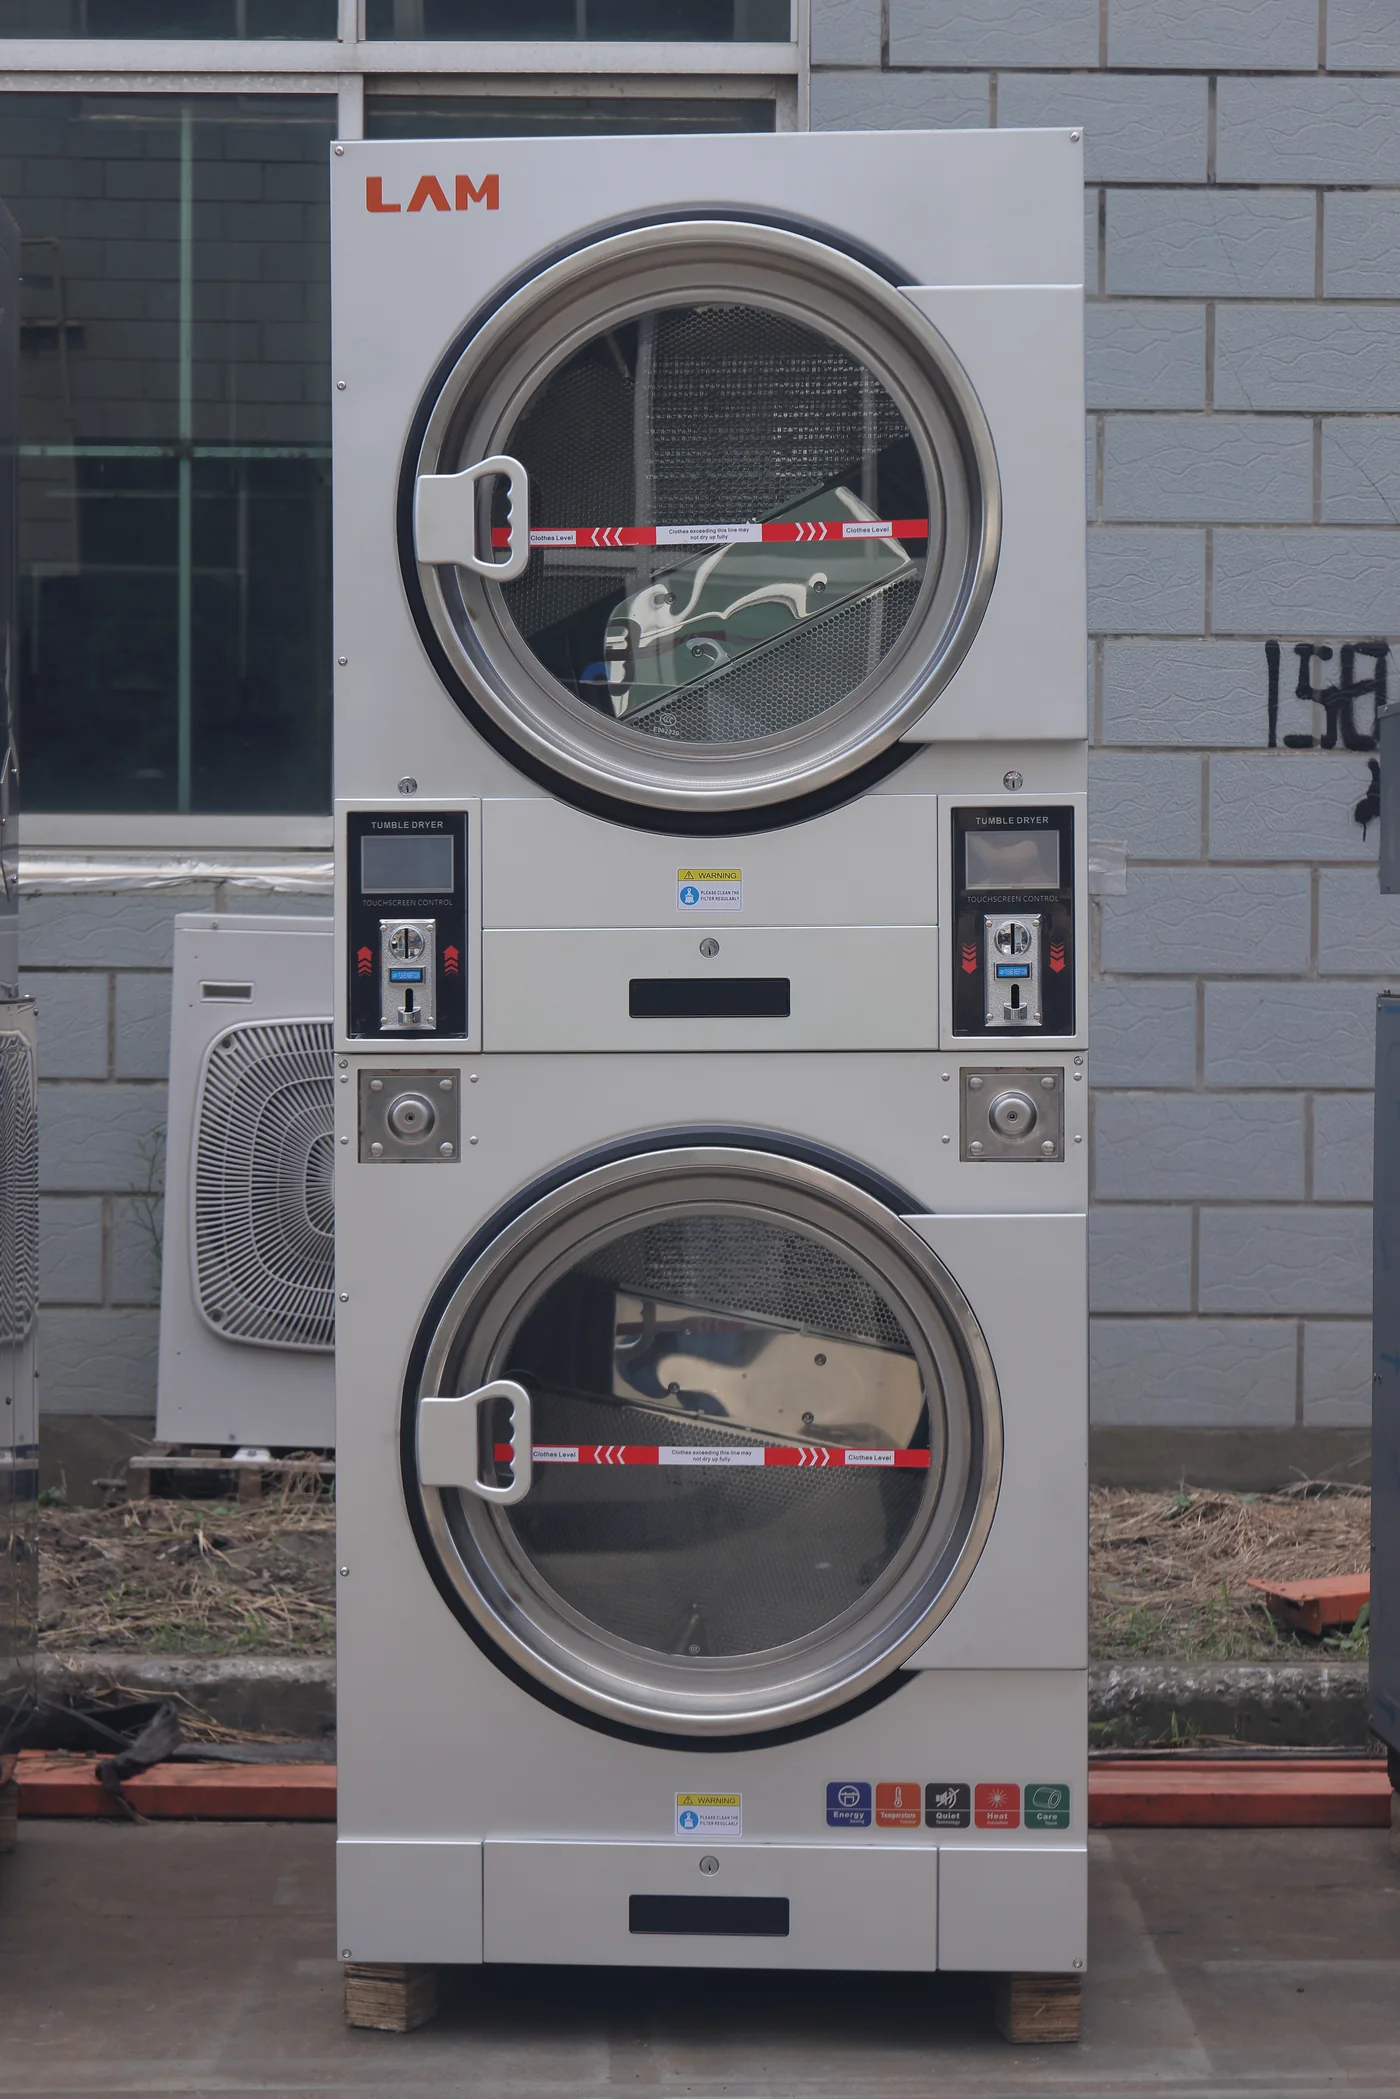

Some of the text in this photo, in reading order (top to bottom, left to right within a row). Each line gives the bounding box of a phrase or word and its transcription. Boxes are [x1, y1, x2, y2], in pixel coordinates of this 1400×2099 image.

[366, 174, 499, 213] LAM
[976, 816, 1049, 825] TUMBLE DRYER
[371, 821, 443, 829] TUMBLE DRYER
[363, 899, 416, 907] TOUCHSCREEN
[967, 895, 1022, 903] TOUCHSCREEN
[532, 1450, 557, 1458] Clothes
[833, 1811, 864, 1819] Energy
